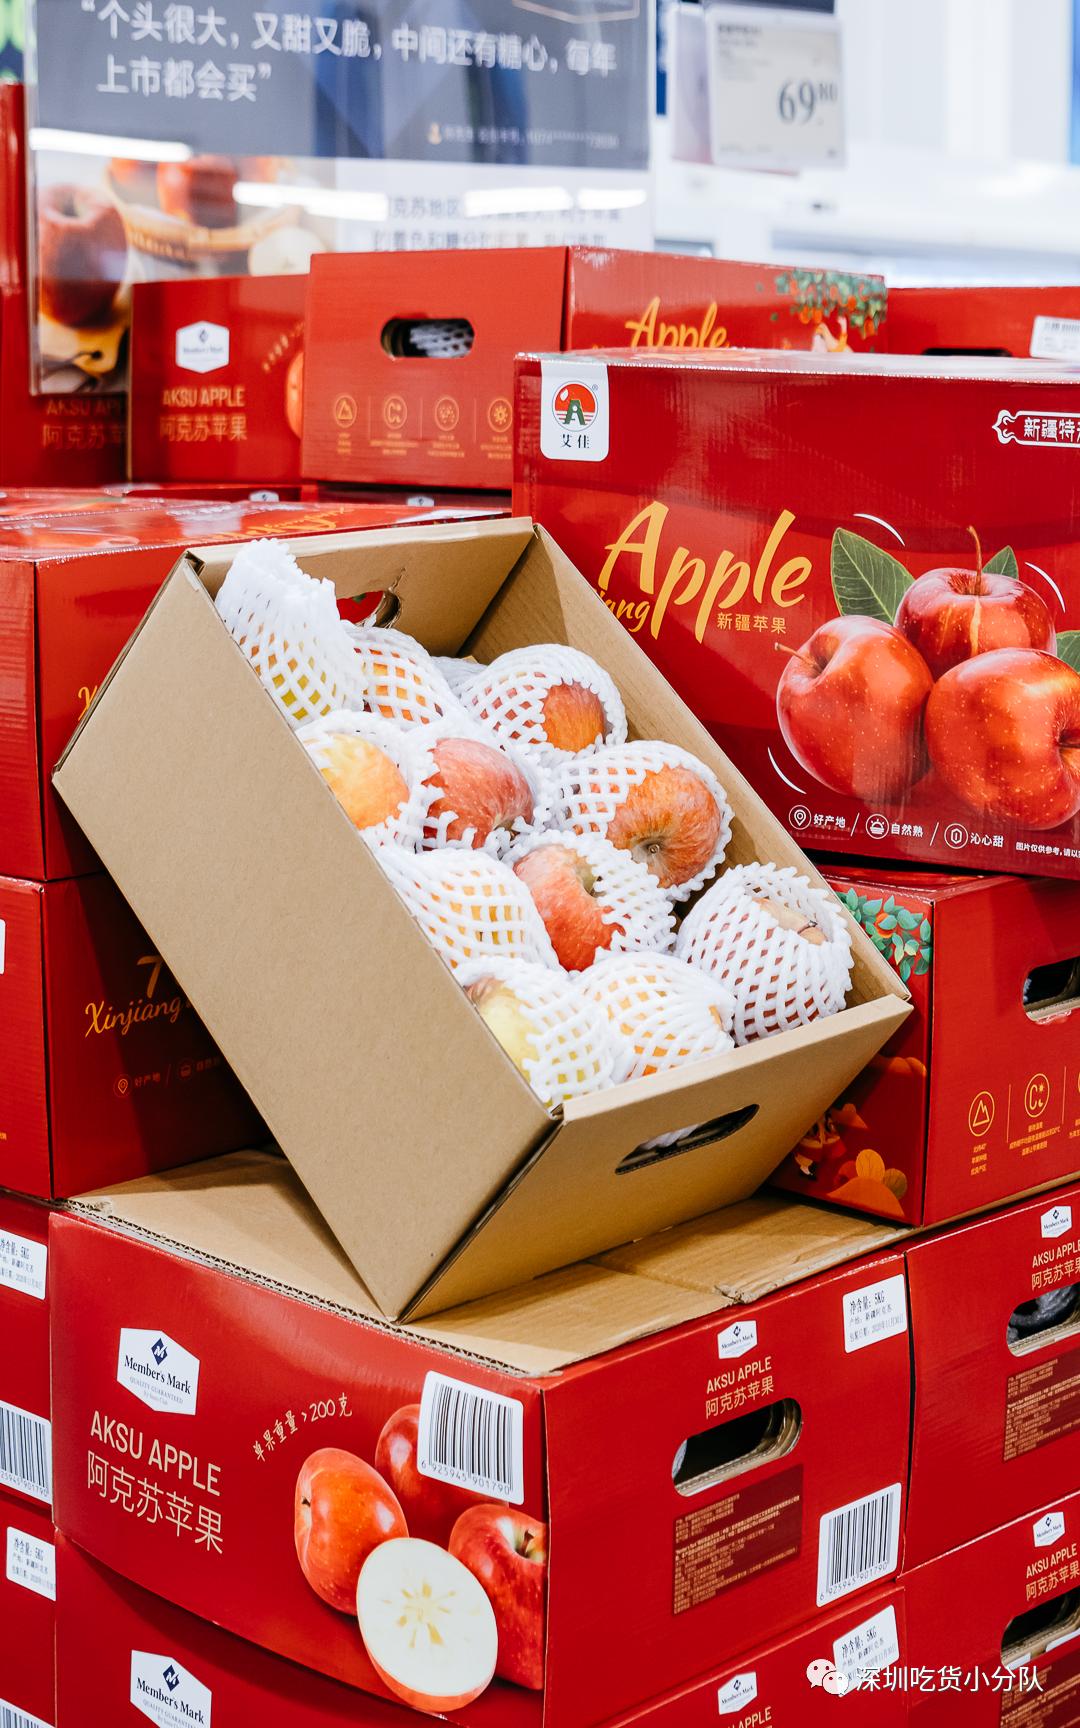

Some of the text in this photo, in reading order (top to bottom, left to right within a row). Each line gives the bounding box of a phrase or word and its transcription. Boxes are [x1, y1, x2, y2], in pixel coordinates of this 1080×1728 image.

[162, 386, 245, 408] AKSU APPLE
[160, 413, 247, 442] 阿克苏苹果
[561, 433, 590, 449] 艾佳
[1023, 416, 1080, 442] 新疆特
[598, 501, 812, 644] Apple
[716, 612, 787, 635] 新疆苹果
[813, 813, 1004, 848] 好产地 自然熟 沁心甜
[85, 997, 181, 1038] Xinjiang
[1032, 1248, 1055, 1269] AKSU
[124, 1354, 191, 1395] Member's Mark
[706, 1356, 772, 1394] AKSU APPLE
[705, 1375, 774, 1420] 阿克苏苹果
[90, 1410, 221, 1497] AKSU APPLE
[87, 1449, 223, 1555] 阿克苏苹果
[1026, 1543, 1078, 1579] AKSU APPLE
[1026, 1560, 1080, 1602] 阿克苏苹果
[137, 1677, 204, 1725] Member's Mark
